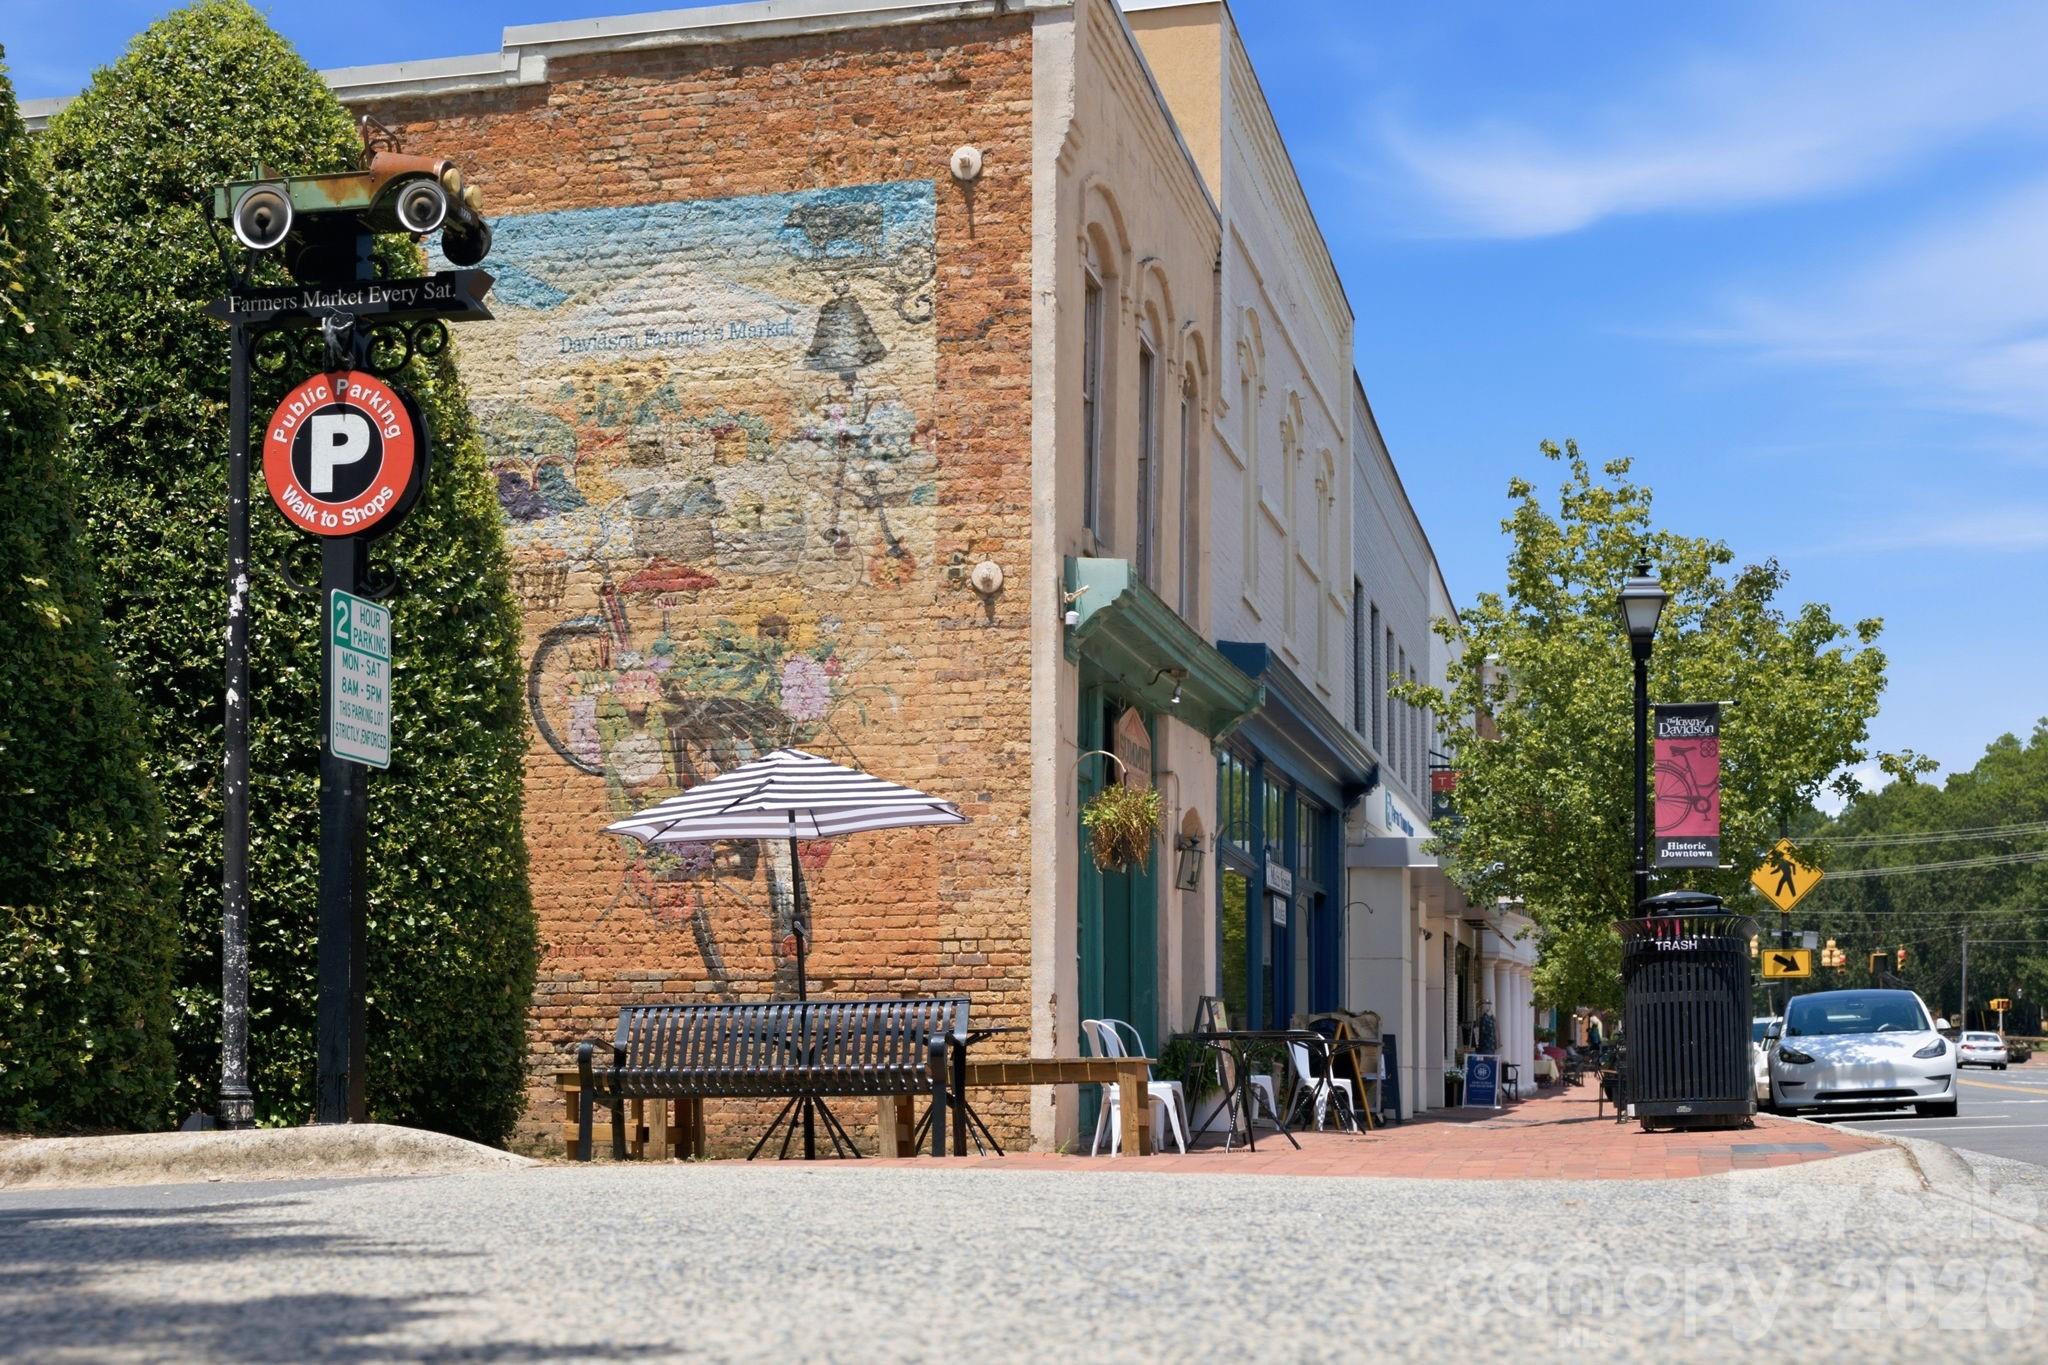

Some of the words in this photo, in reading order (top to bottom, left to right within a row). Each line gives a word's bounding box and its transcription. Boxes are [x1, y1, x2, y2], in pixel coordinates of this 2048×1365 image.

[229, 295, 297, 313] Farmers
[302, 290, 364, 309] Market
[368, 285, 419, 304] Every
[424, 281, 456, 299] Sat.
[558, 332, 639, 353] Davidson
[728, 318, 795, 341] Market
[273, 385, 327, 443] Public
[336, 379, 401, 439] Parking
[311, 413, 370, 494] P
[282, 484, 319, 523] Walk
[320, 510, 338, 528] to
[342, 486, 393, 526] Shops
[336, 600, 349, 640] 2
[360, 605, 381, 631] HOUR
[353, 627, 387, 655] PARKING
[342, 650, 359, 673] MON
[366, 659, 382, 679] SAT
[341, 676, 359, 697] 8AM
[366, 684, 382, 705] 5PM
[339, 700, 351, 718] THIS
[352, 703, 374, 724] PARKING
[374, 711, 384, 727] LOT
[335, 721, 360, 743] STRICTLY
[361, 728, 387, 751] ENFORCED
[1659, 722, 1714, 735] Davidson
[1661, 849, 1713, 858] Downtown
[1667, 841, 1707, 850] Historic
[1655, 940, 1698, 952] TRASH
